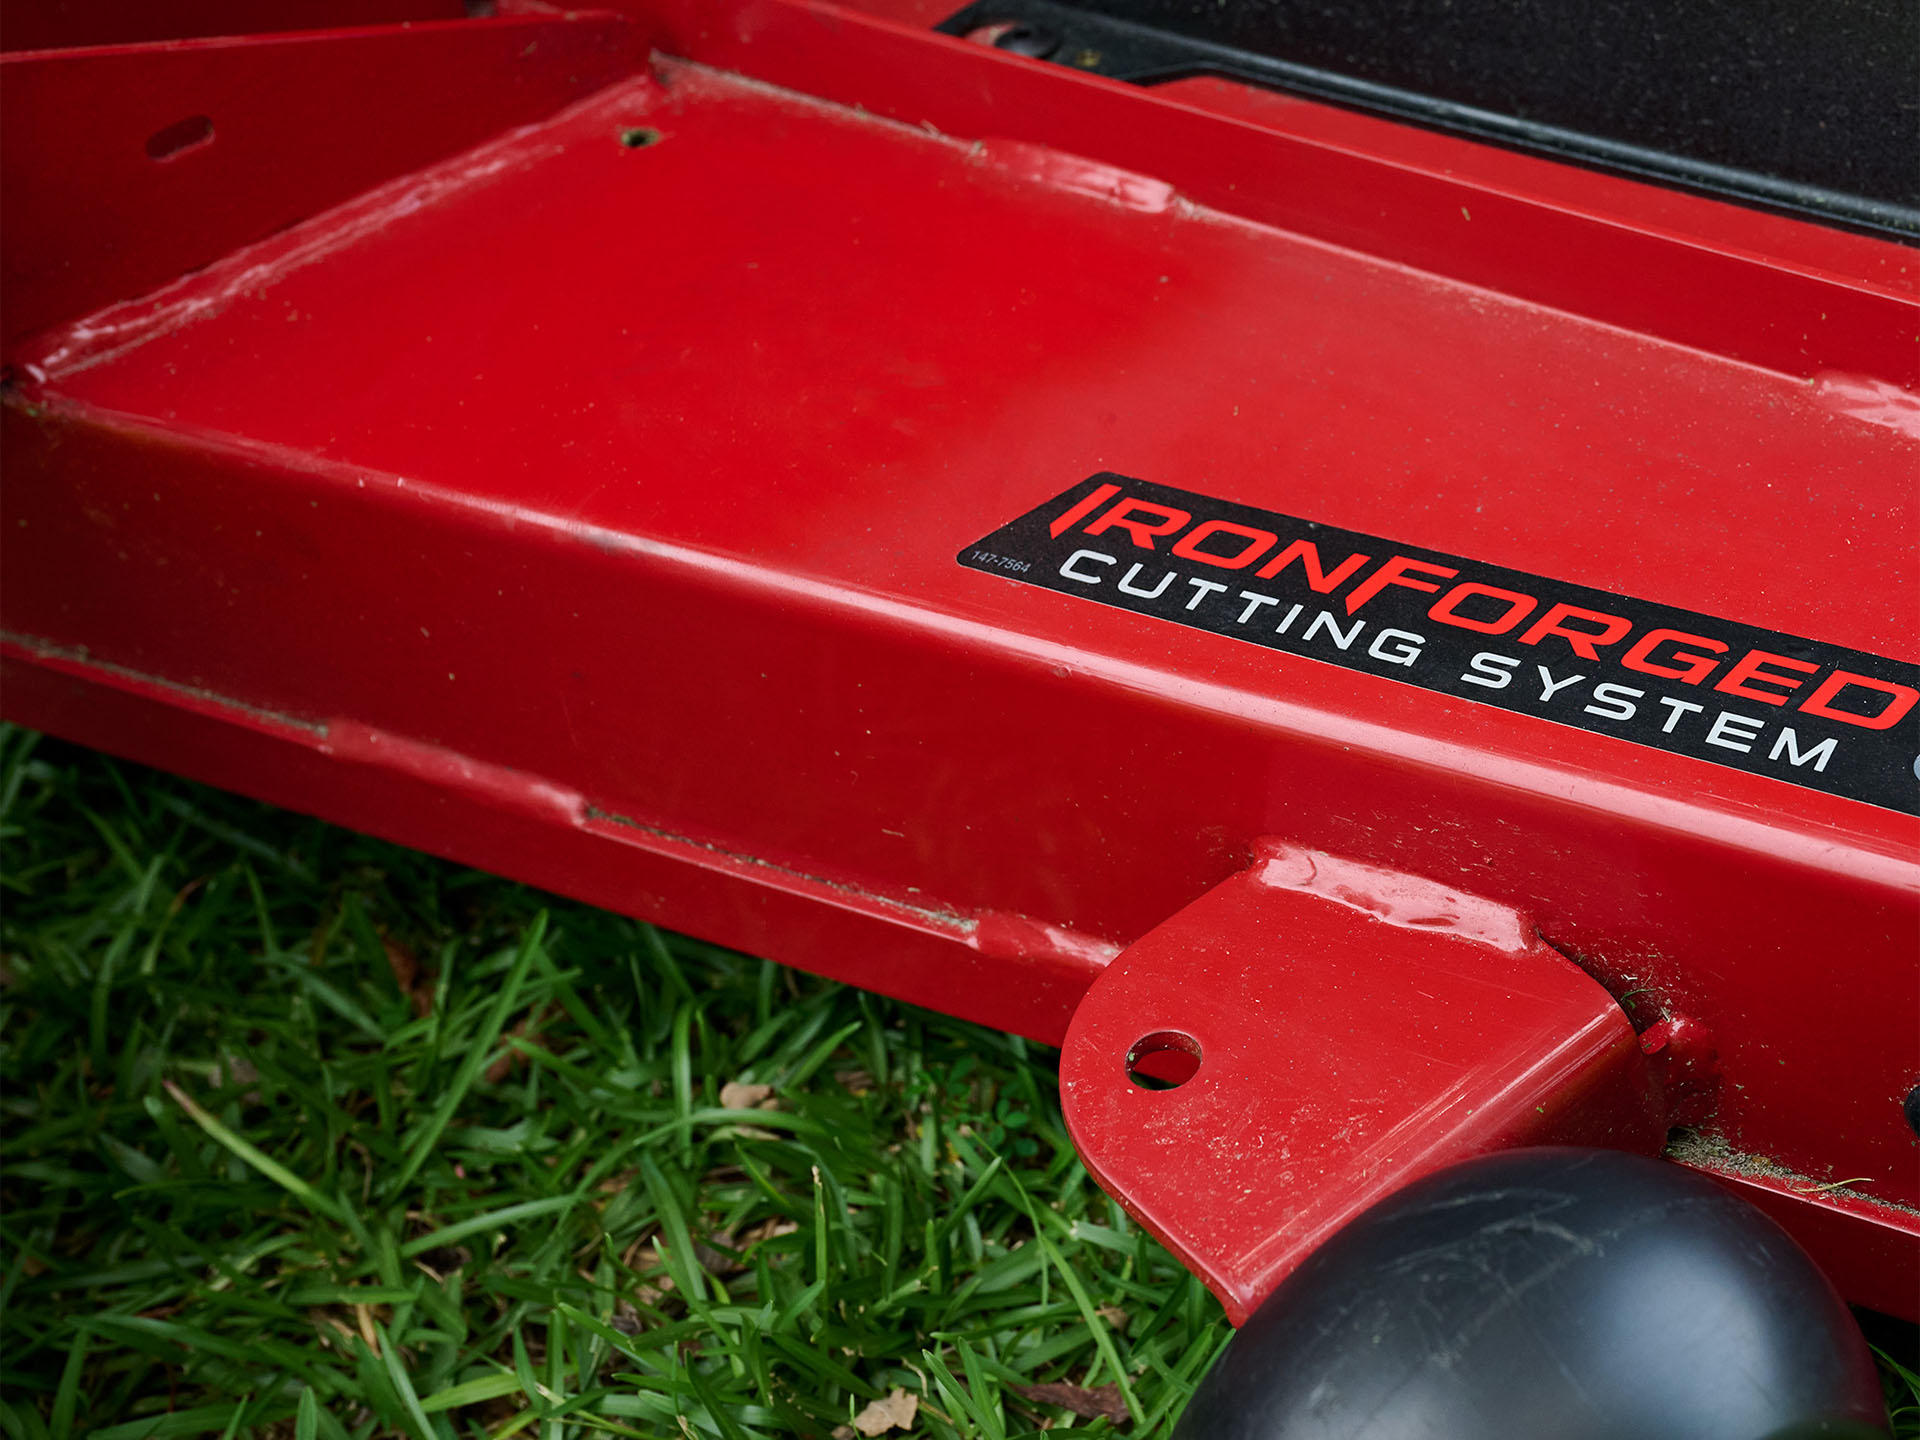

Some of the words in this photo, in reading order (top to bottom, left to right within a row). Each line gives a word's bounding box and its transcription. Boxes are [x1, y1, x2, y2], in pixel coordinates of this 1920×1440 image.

[971, 550, 1031, 573] 147-7564
[1059, 549, 1426, 667] CUTTING
[1460, 652, 1839, 773] SYSTEM
